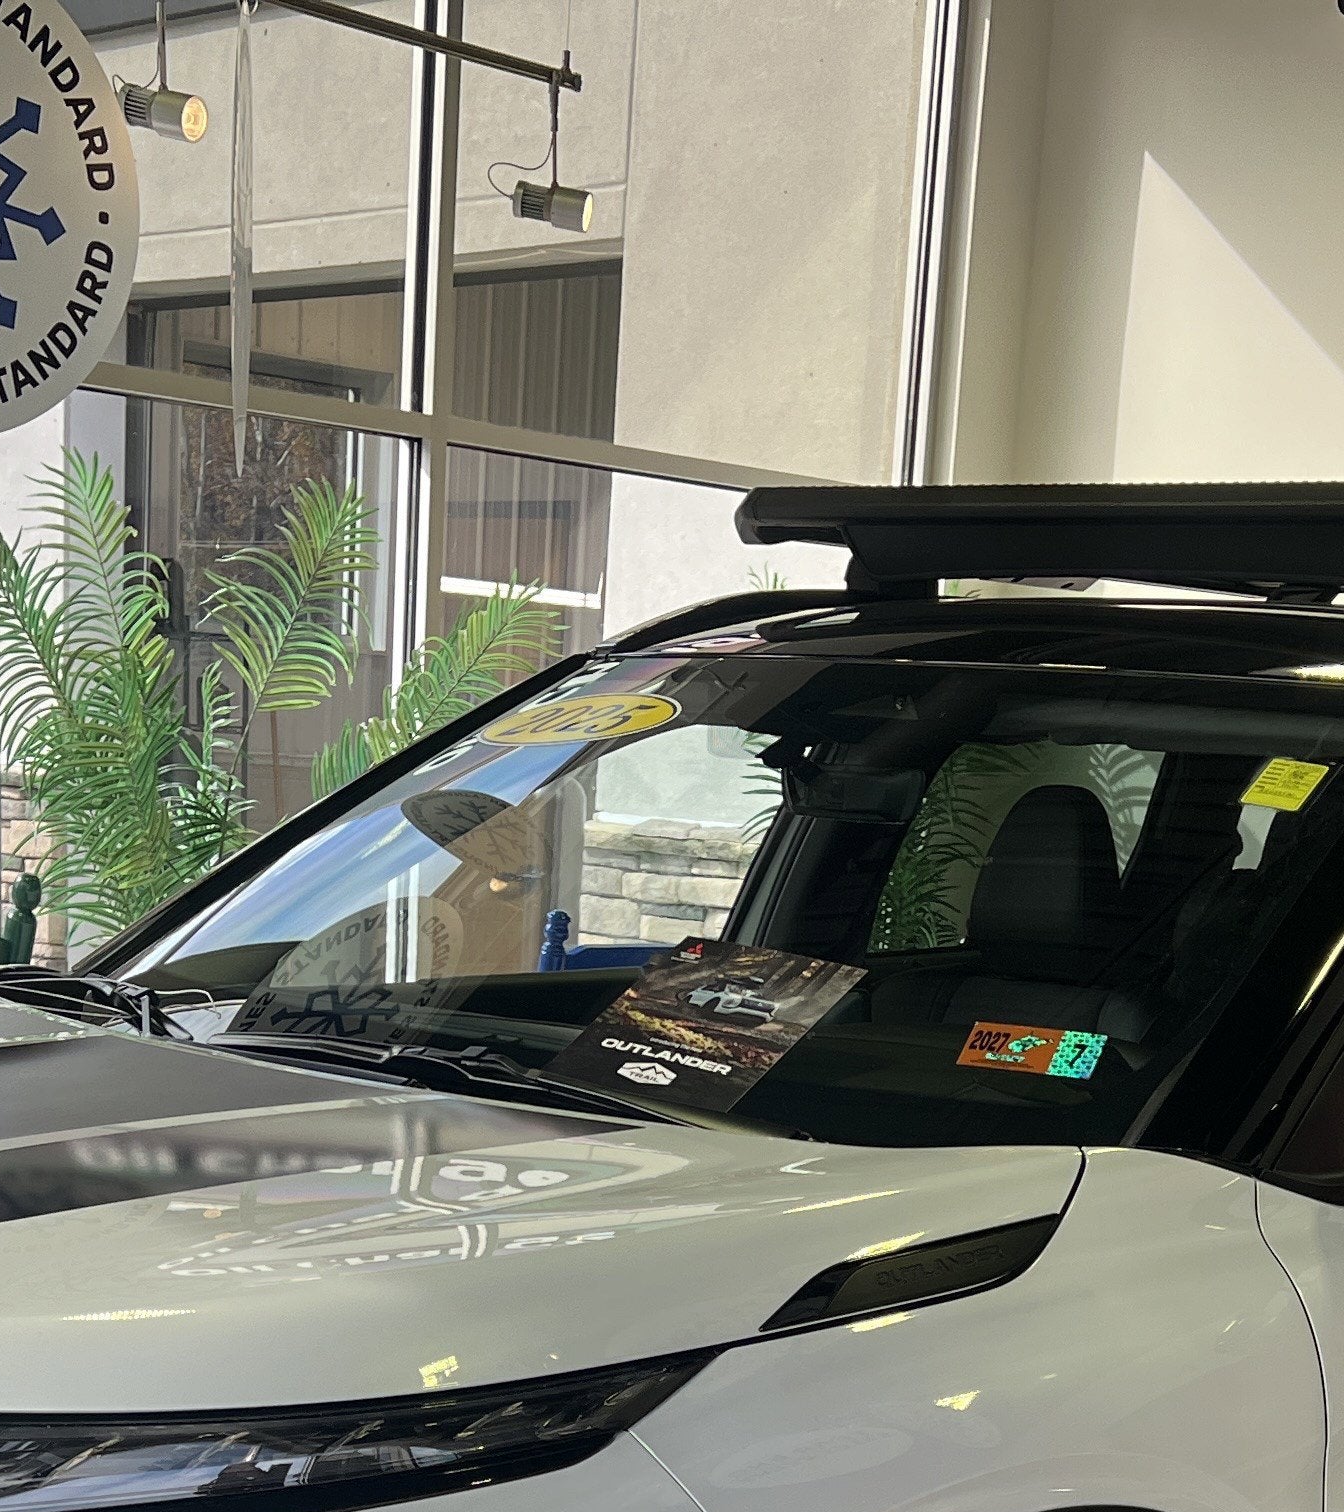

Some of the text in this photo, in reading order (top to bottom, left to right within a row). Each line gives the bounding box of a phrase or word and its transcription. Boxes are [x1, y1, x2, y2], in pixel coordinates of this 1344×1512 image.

[600, 1037, 733, 1077] OUTLANDER
[969, 1029, 1088, 1069] 2027 7
[628, 1070, 659, 1084] TRAIL
